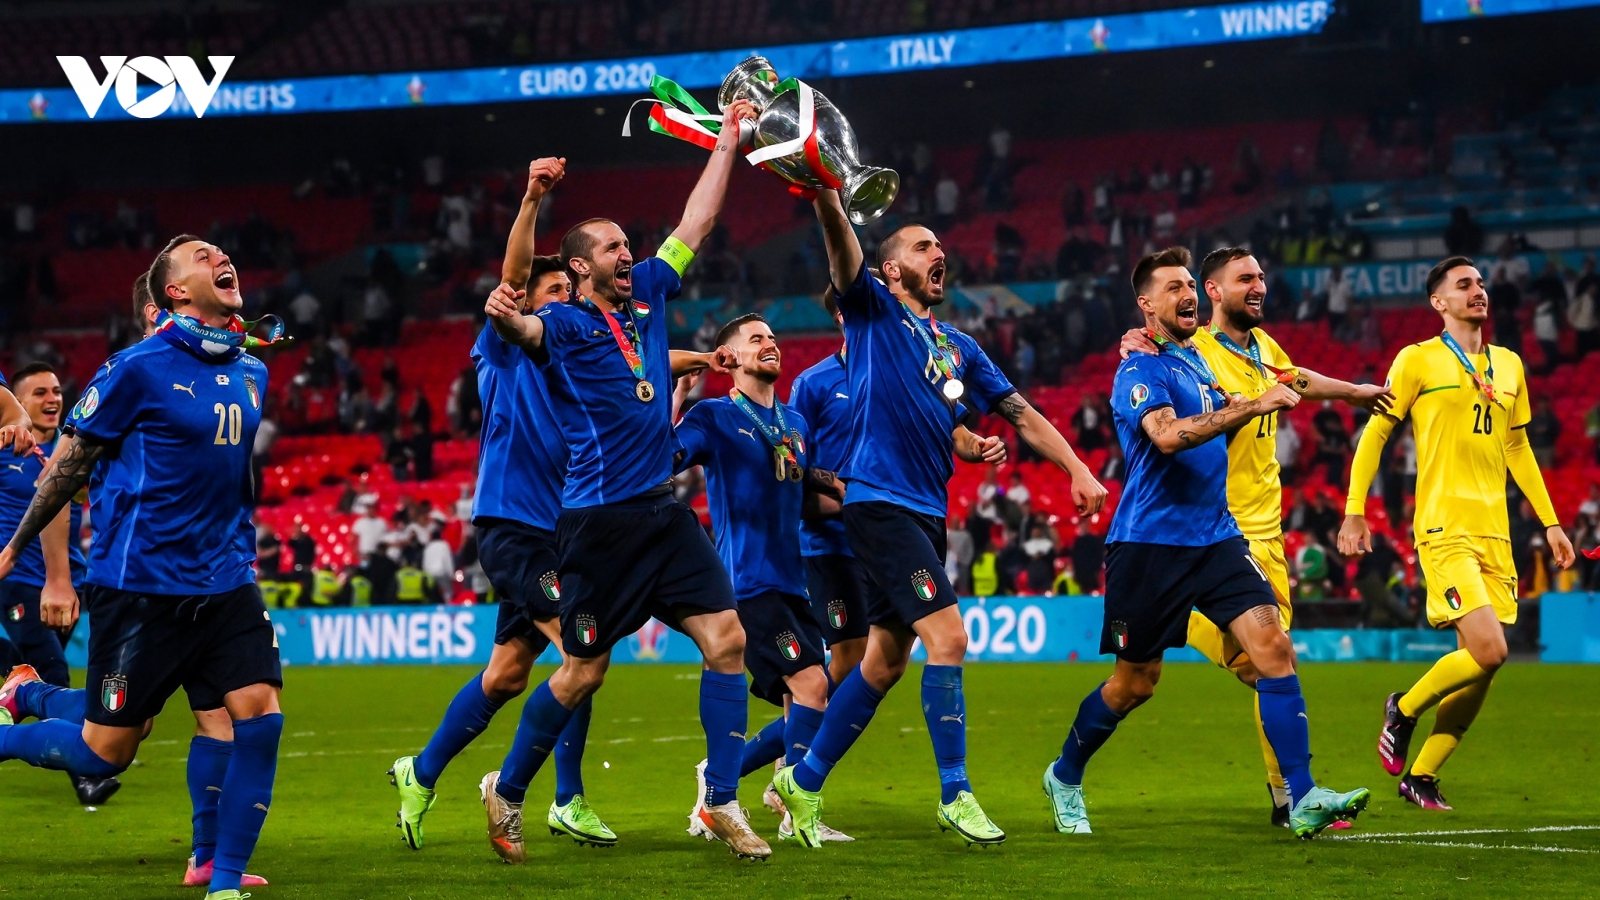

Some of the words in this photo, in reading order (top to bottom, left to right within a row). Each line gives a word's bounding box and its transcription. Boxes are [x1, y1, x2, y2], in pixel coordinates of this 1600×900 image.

[890, 35, 956, 68] ITALY
[519, 66, 588, 96] EURO
[594, 62, 657, 91] 2020
[1378, 263, 1432, 294] EUR
[190, 324, 209, 337] EURO
[209, 331, 228, 340] UEFA
[1174, 350, 1186, 361] UEFA
[742, 403, 753, 415] 2020
[1197, 383, 1214, 414] 15
[213, 402, 243, 446] 20
[1473, 403, 1493, 435] 26
[311, 611, 476, 659] WINNERS
[962, 604, 1047, 655] 020
